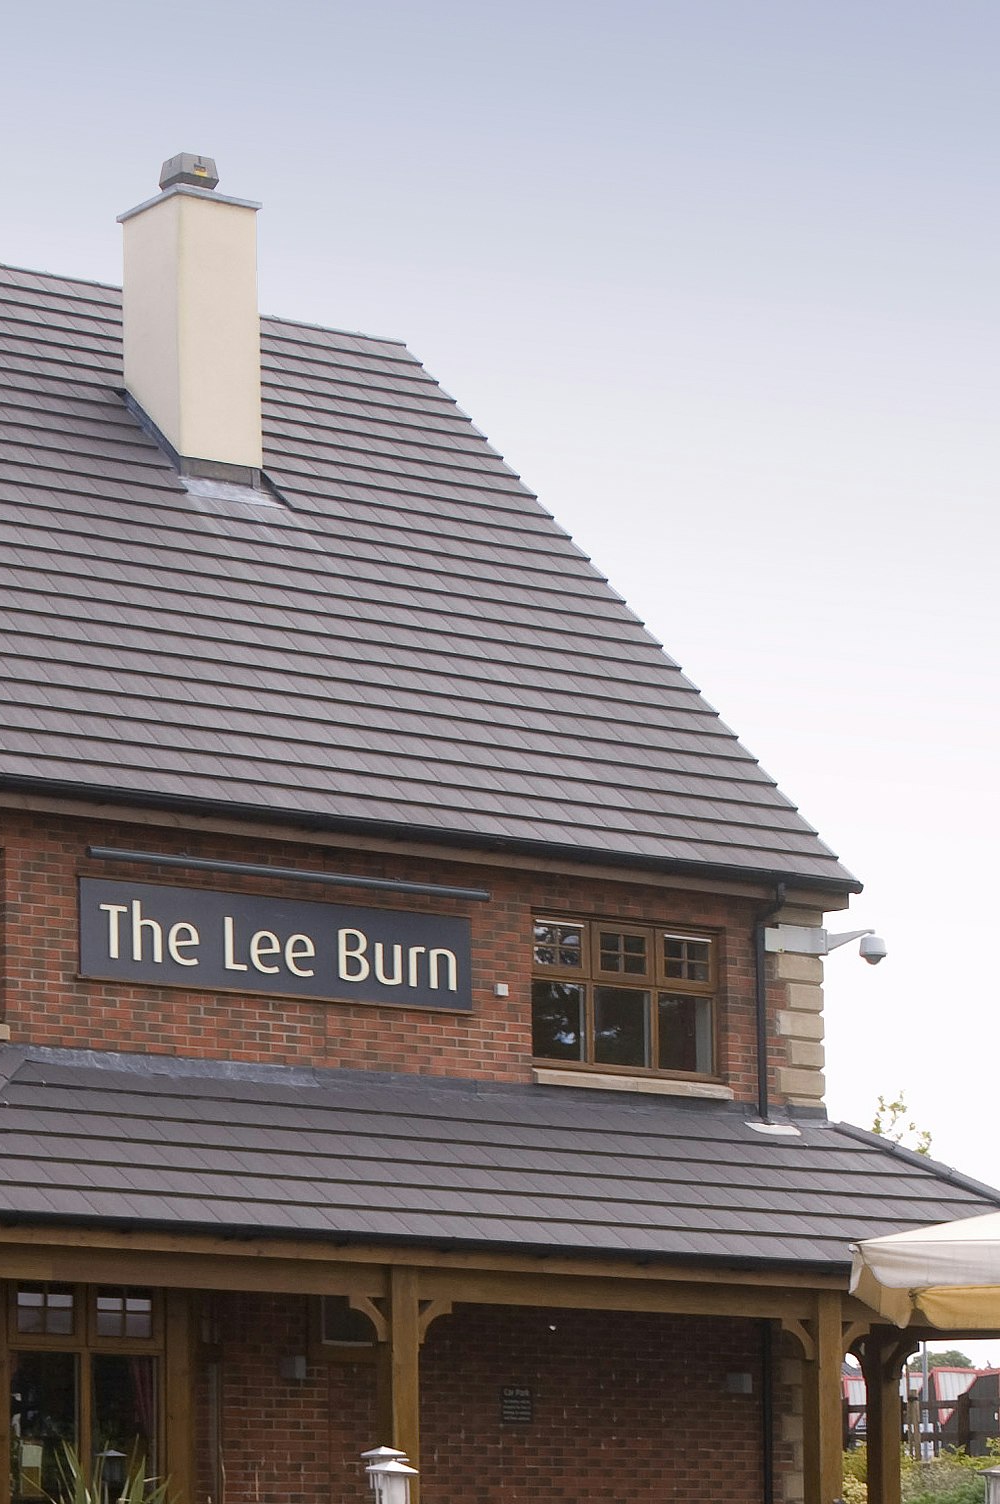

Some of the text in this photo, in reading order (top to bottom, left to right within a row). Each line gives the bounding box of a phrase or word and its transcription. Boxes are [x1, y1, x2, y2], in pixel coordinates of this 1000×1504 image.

[99, 900, 457, 992] The Lee Burn
